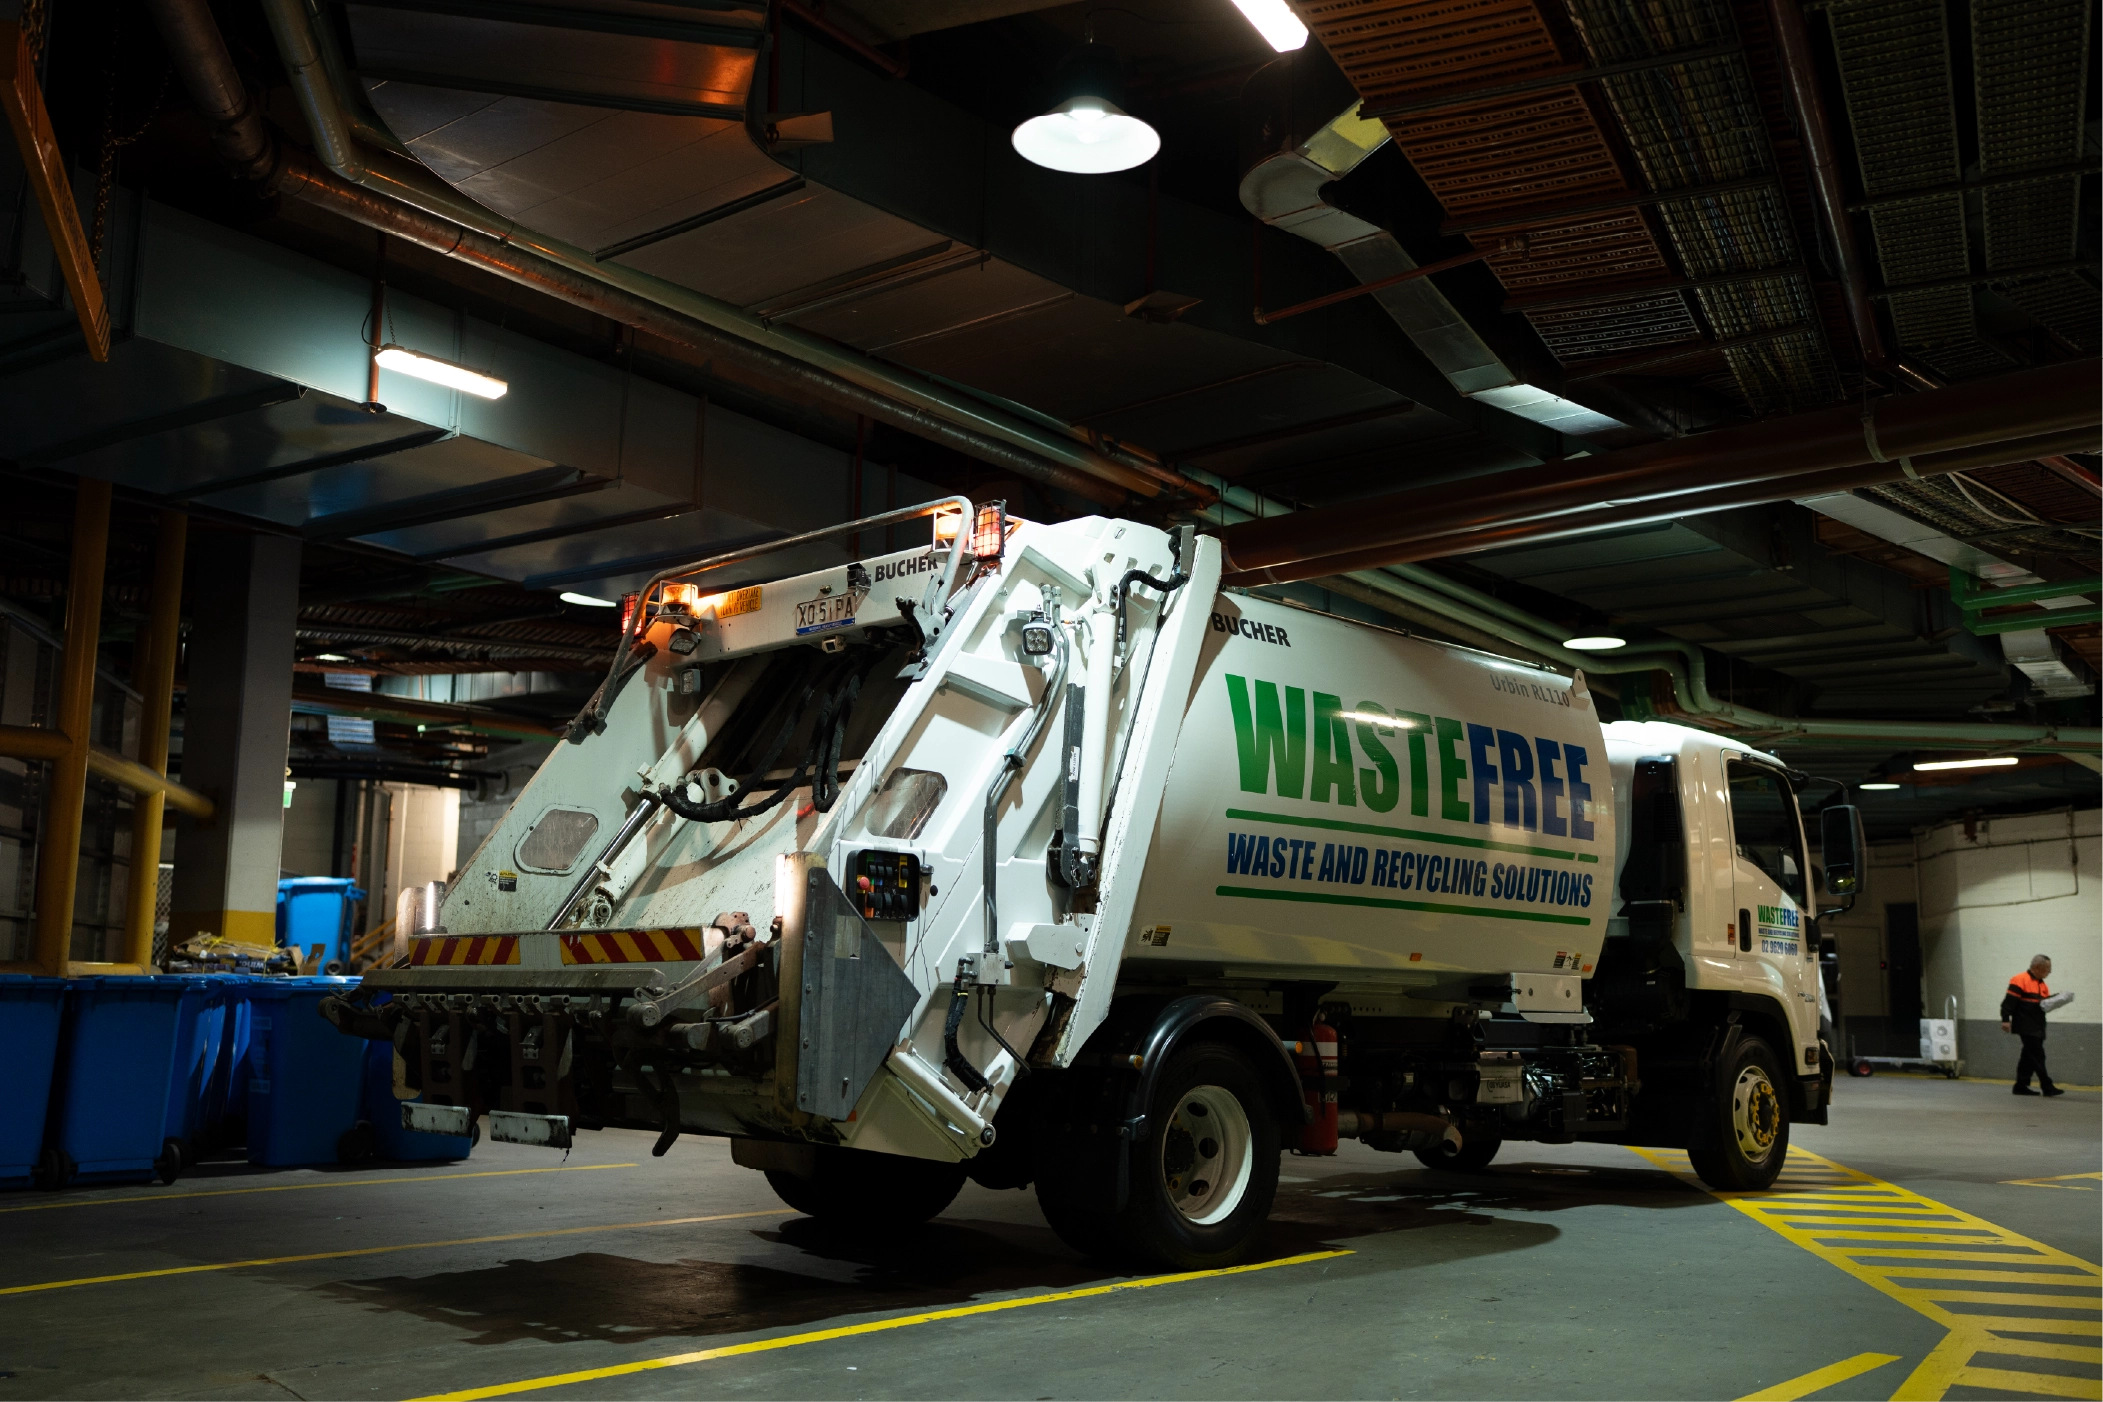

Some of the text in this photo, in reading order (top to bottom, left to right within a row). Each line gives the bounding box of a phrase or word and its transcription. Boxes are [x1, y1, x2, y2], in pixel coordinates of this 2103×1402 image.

[1211, 612, 1291, 648] BUCHER
[1490, 673, 1570, 708] Urbin RL110
[1225, 673, 1595, 841] WASTEFREE
[1227, 832, 1593, 908] WASTE AND RECYCLING SOLUTIONS
[1758, 905, 1798, 927] WASTEFREE
[1762, 940, 1768, 953] 02
